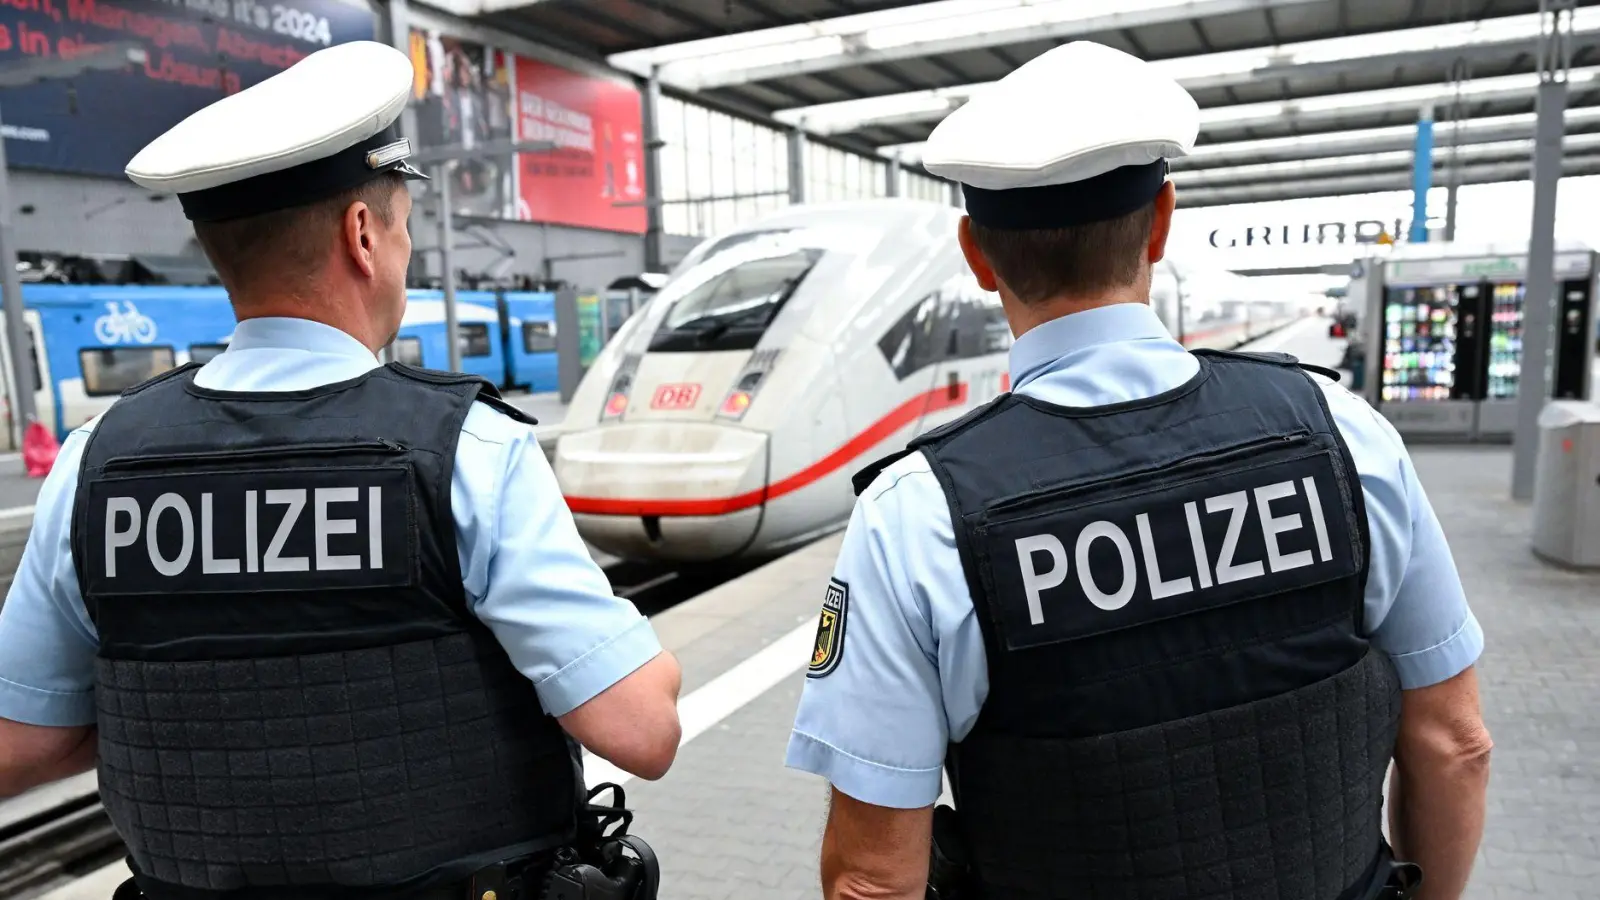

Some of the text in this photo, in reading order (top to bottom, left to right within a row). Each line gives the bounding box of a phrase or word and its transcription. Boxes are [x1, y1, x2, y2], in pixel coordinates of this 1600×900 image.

[17, 21, 49, 57] in
[271, 4, 332, 46] 2024
[1208, 218, 1412, 248] GRUNDI
[105, 486, 383, 577] POLIZEI
[1015, 476, 1333, 625] POLIZEI
[824, 588, 842, 609] IZEI
